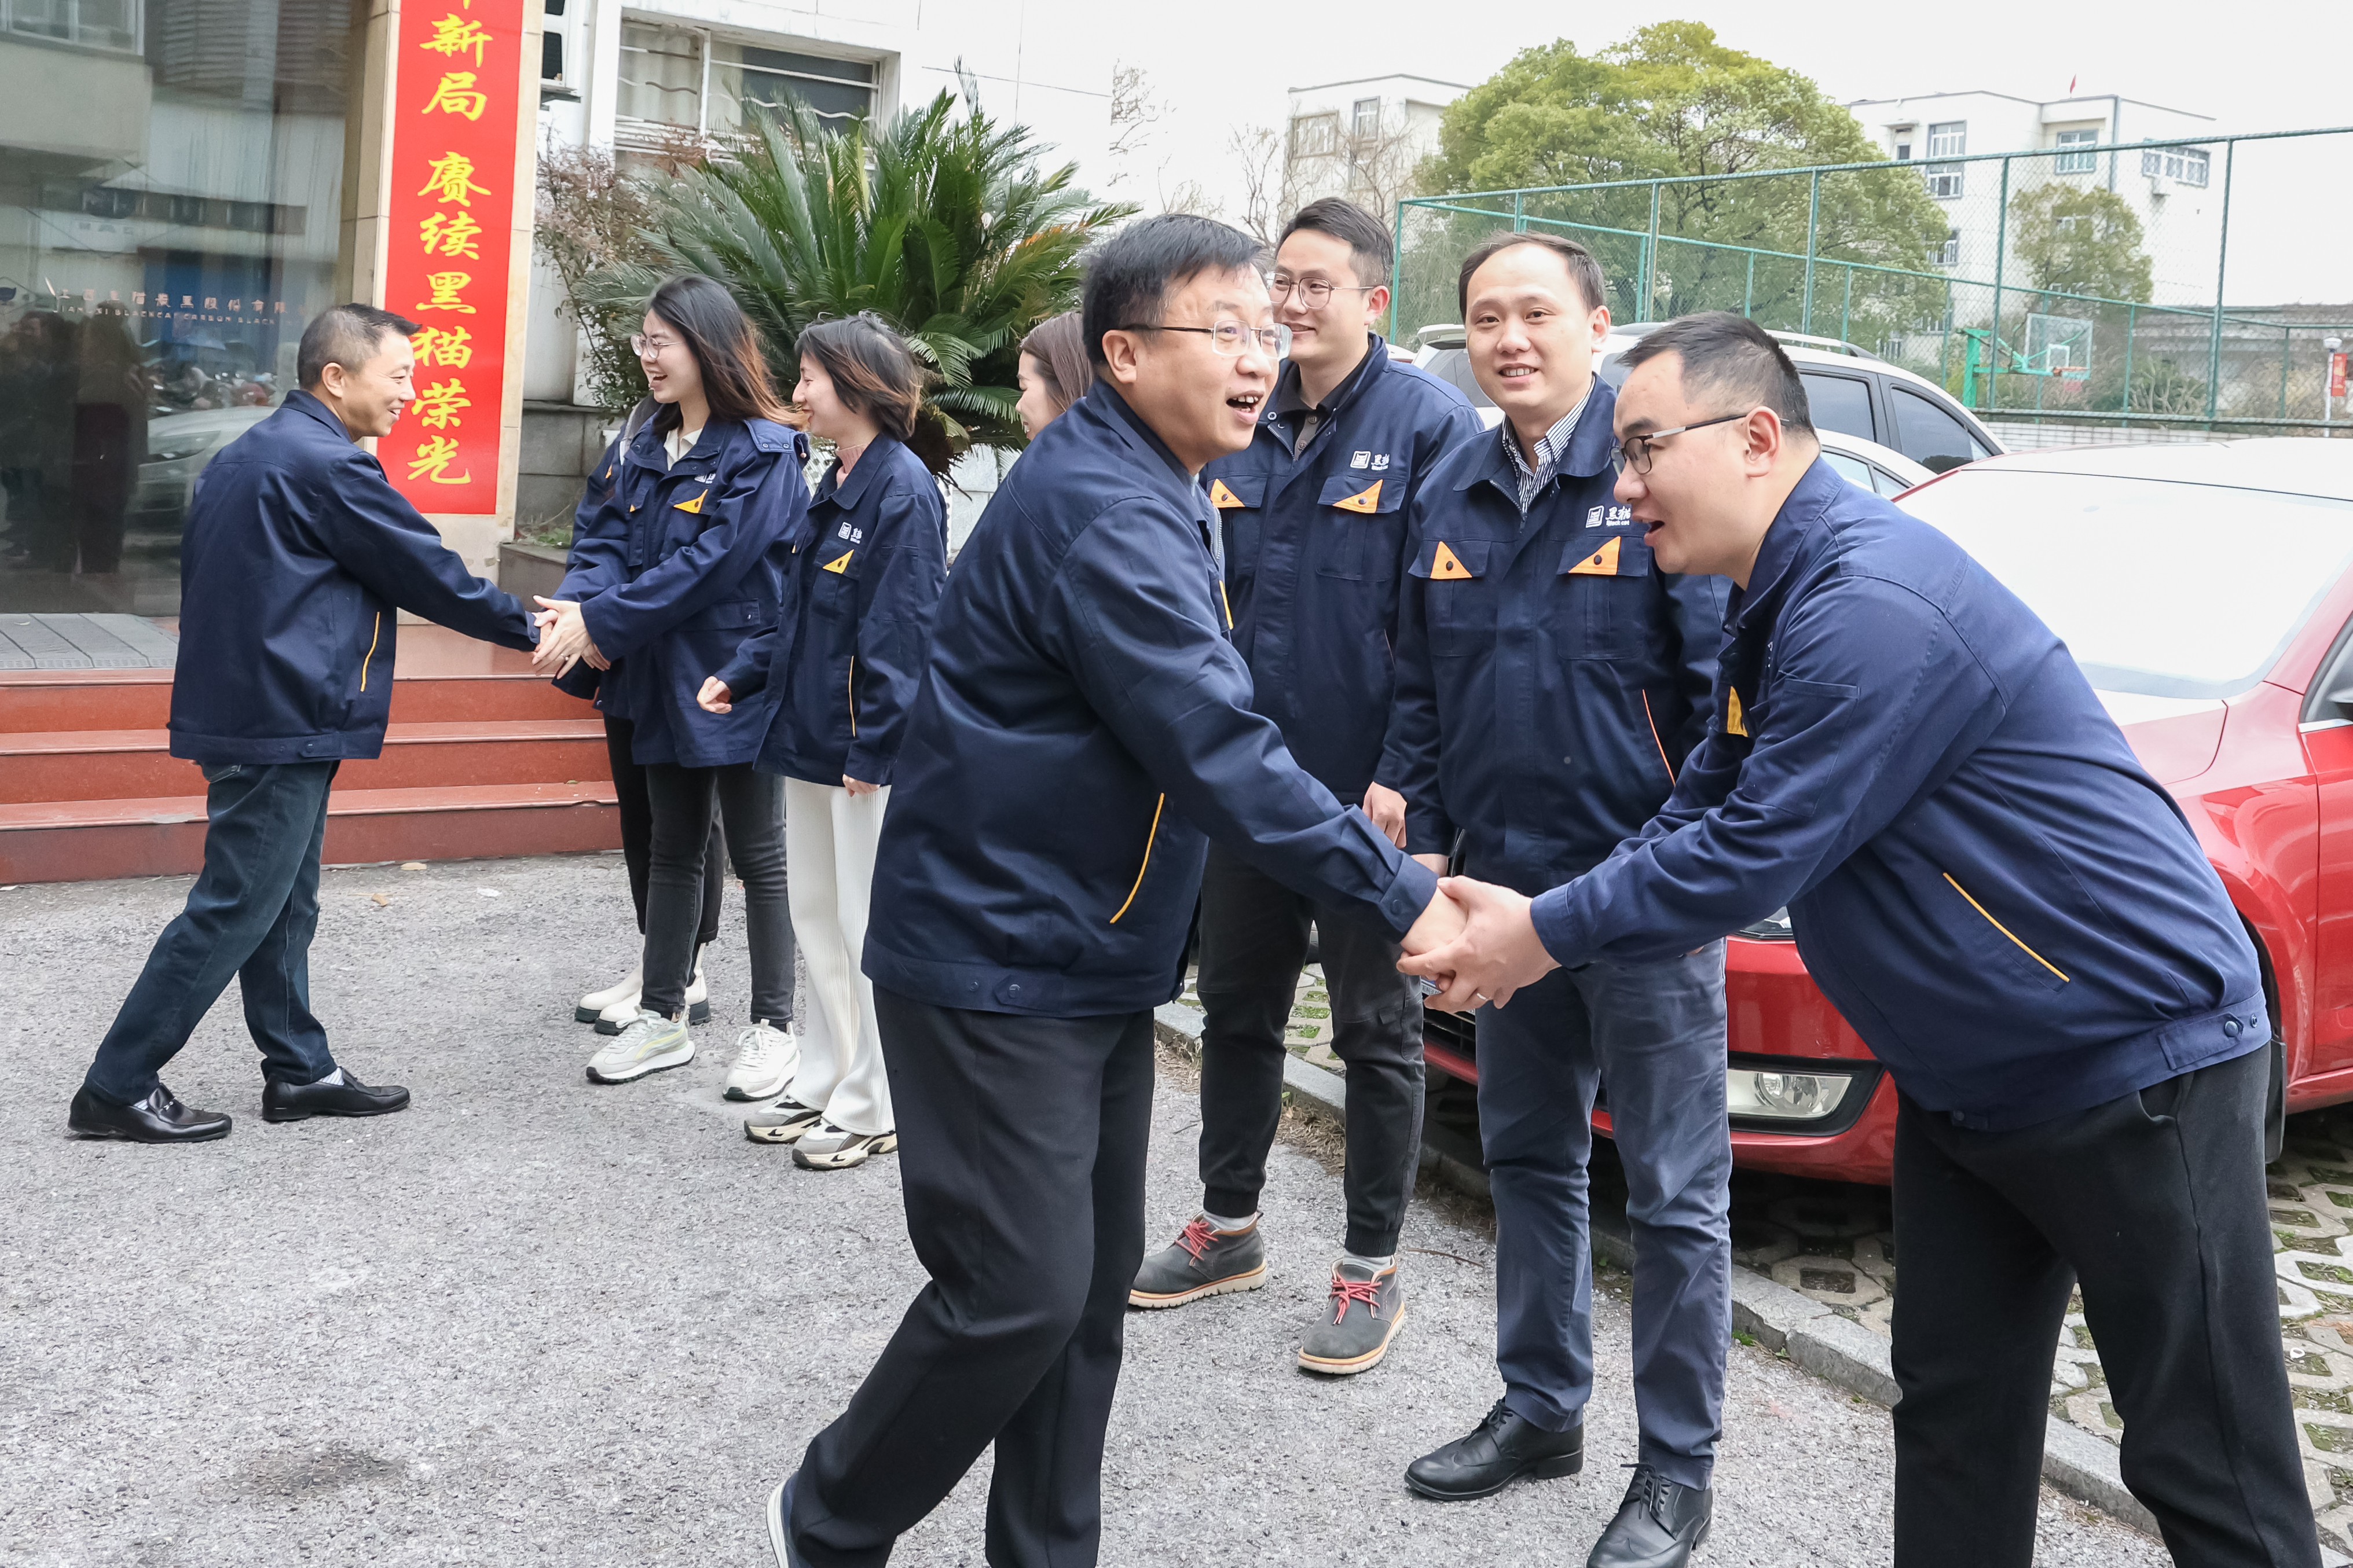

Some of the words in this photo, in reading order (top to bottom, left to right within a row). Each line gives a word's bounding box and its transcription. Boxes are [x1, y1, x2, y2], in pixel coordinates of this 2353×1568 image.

[420, 0, 493, 121] 新局
[408, 151, 492, 484] 赓续黑猫荣光
